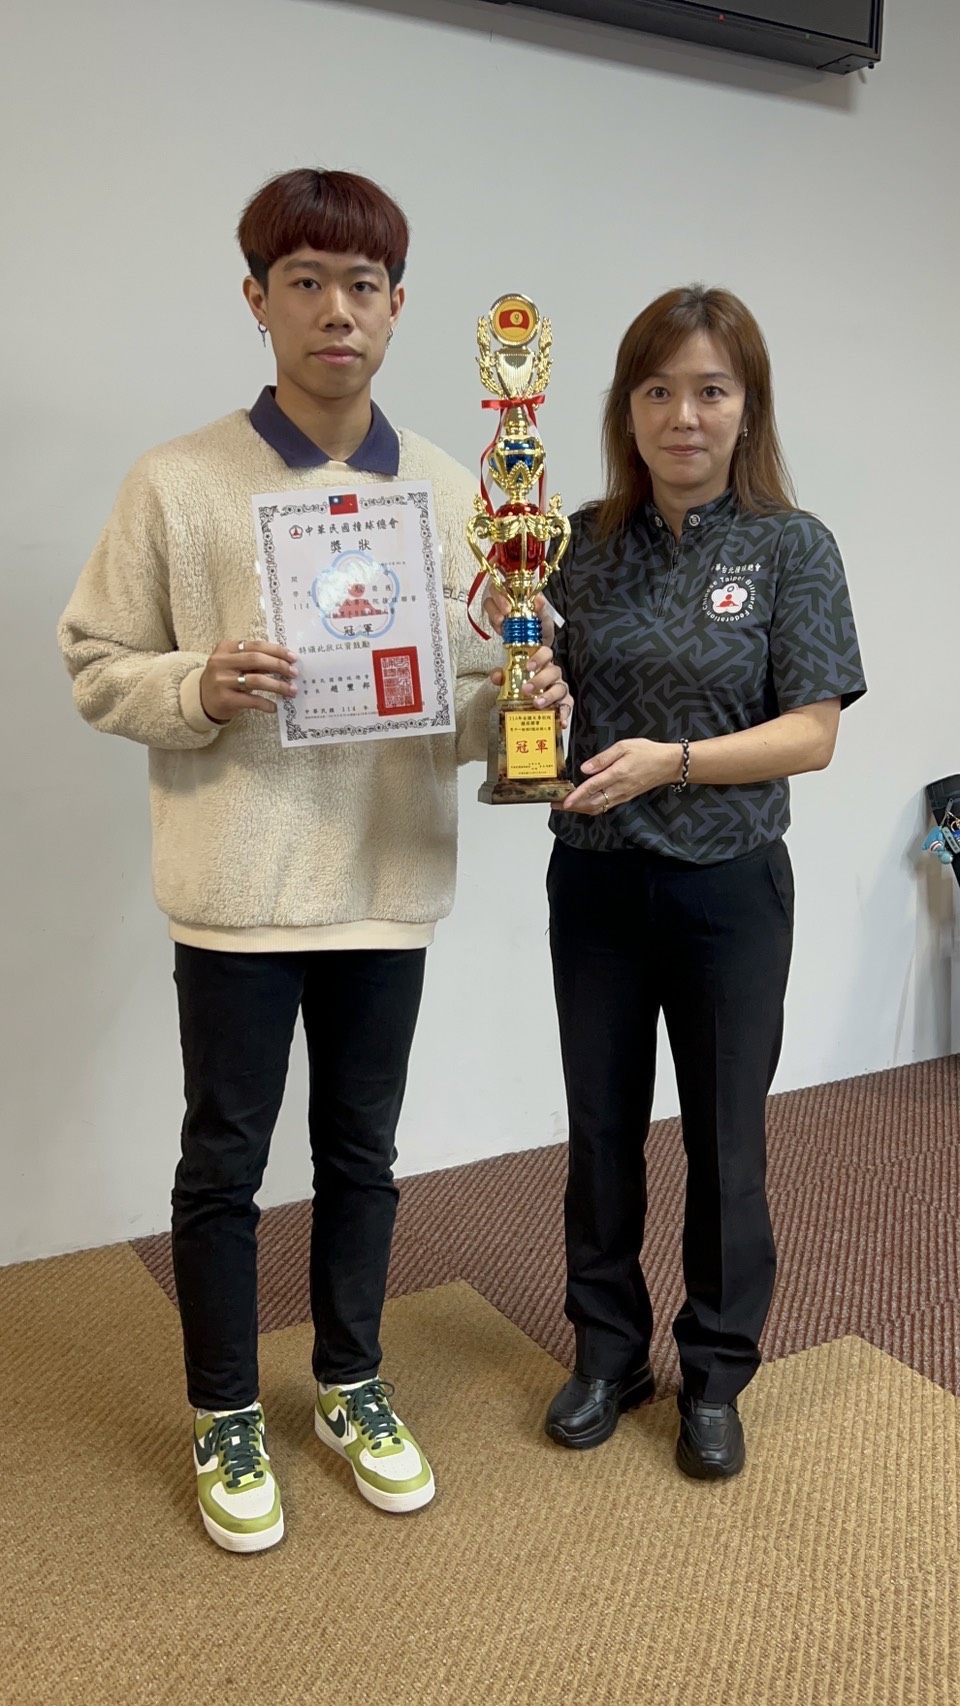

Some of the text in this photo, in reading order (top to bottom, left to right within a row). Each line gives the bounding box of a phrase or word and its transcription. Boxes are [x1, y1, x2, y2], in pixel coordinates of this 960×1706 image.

[304, 517, 399, 536] 中華民國撞球總會
[330, 539, 372, 553] 獎狀
[719, 575, 746, 583] Taipei
[343, 623, 373, 637] 冠軍
[515, 739, 548, 754] 冠軍
